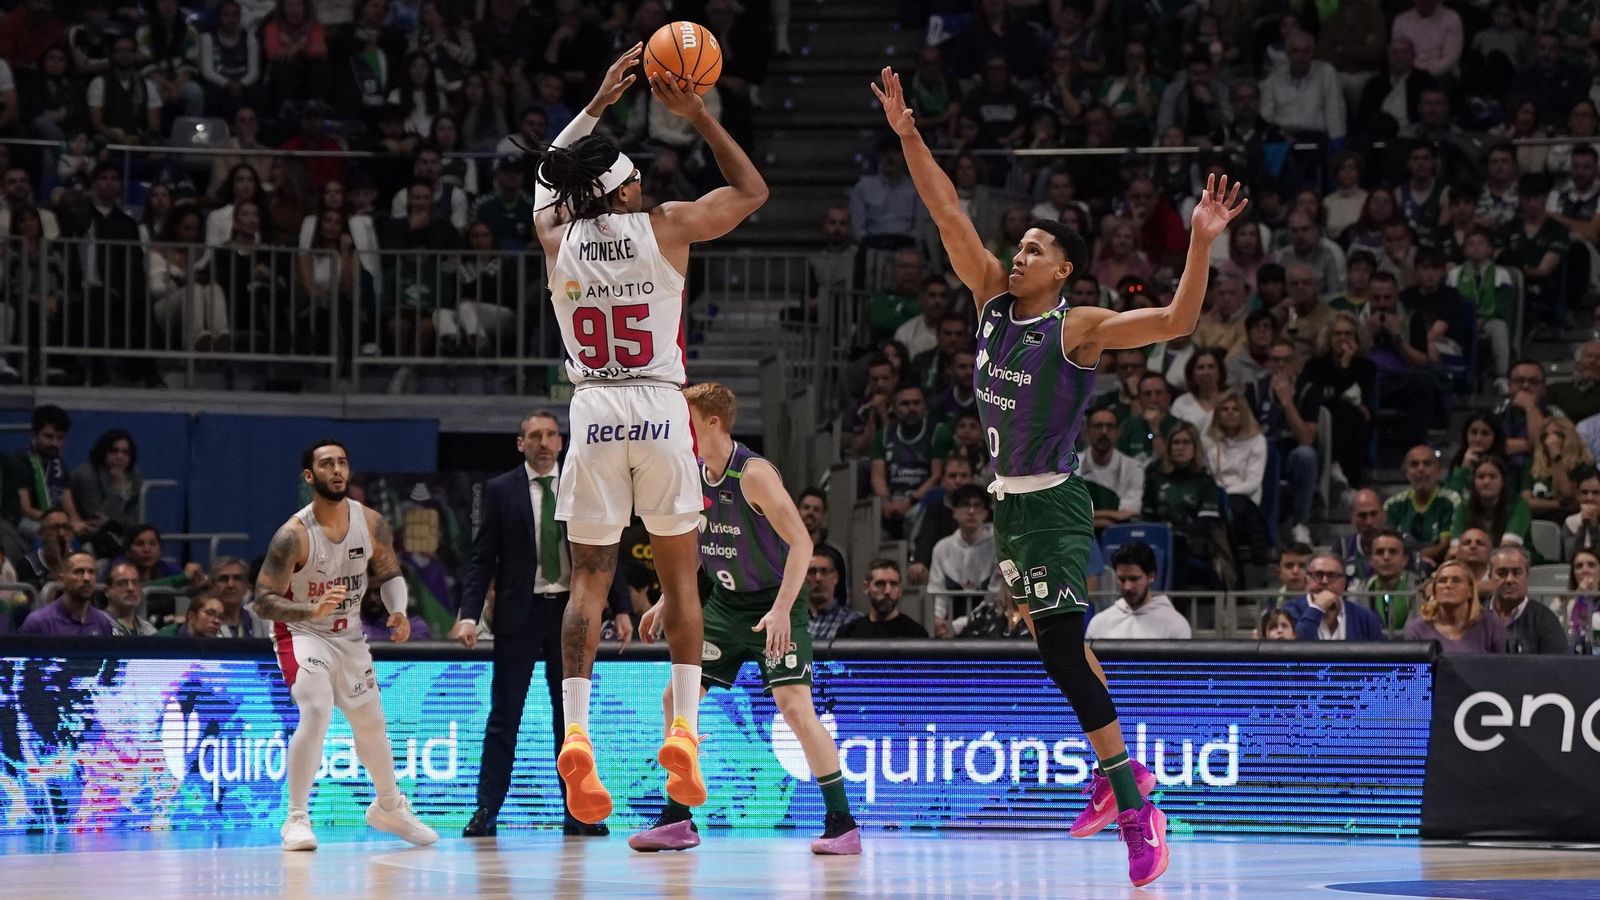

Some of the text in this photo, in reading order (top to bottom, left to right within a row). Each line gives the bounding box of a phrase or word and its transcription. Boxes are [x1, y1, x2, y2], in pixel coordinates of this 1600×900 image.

[579, 237, 634, 261] MONEKE
[586, 281, 654, 298] AMUTIO
[572, 303, 655, 370] 95
[987, 362, 1032, 387] Unicaja
[976, 387, 1016, 411] málaga
[586, 419, 670, 445] Recalvi
[987, 426, 1000, 458] 0
[716, 569, 736, 591] 9
[839, 722, 1240, 803] quirónslud
